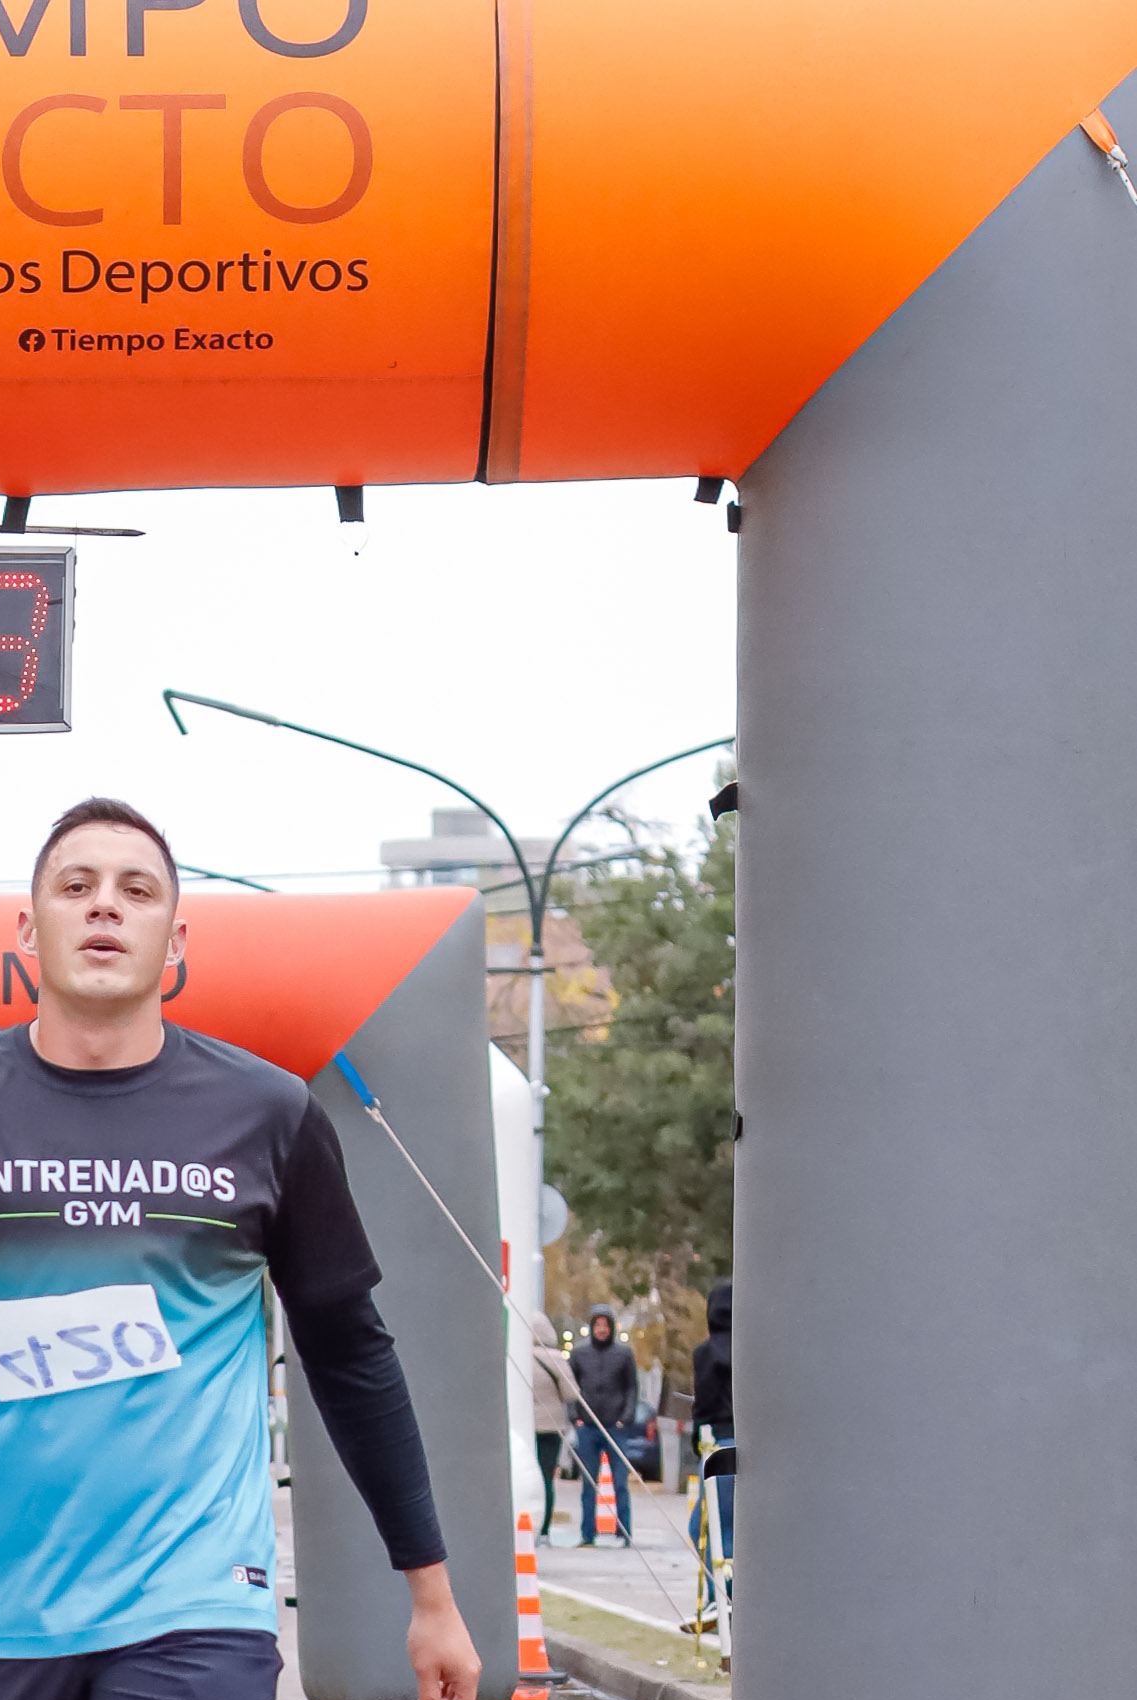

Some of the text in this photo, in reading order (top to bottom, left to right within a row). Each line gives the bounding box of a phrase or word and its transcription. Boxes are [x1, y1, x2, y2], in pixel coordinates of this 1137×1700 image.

[62, 249, 369, 304] Deportivos
[52, 328, 165, 357] Tiempo
[174, 328, 274, 351] Exacto
[64, 1201, 141, 1226] GYM
